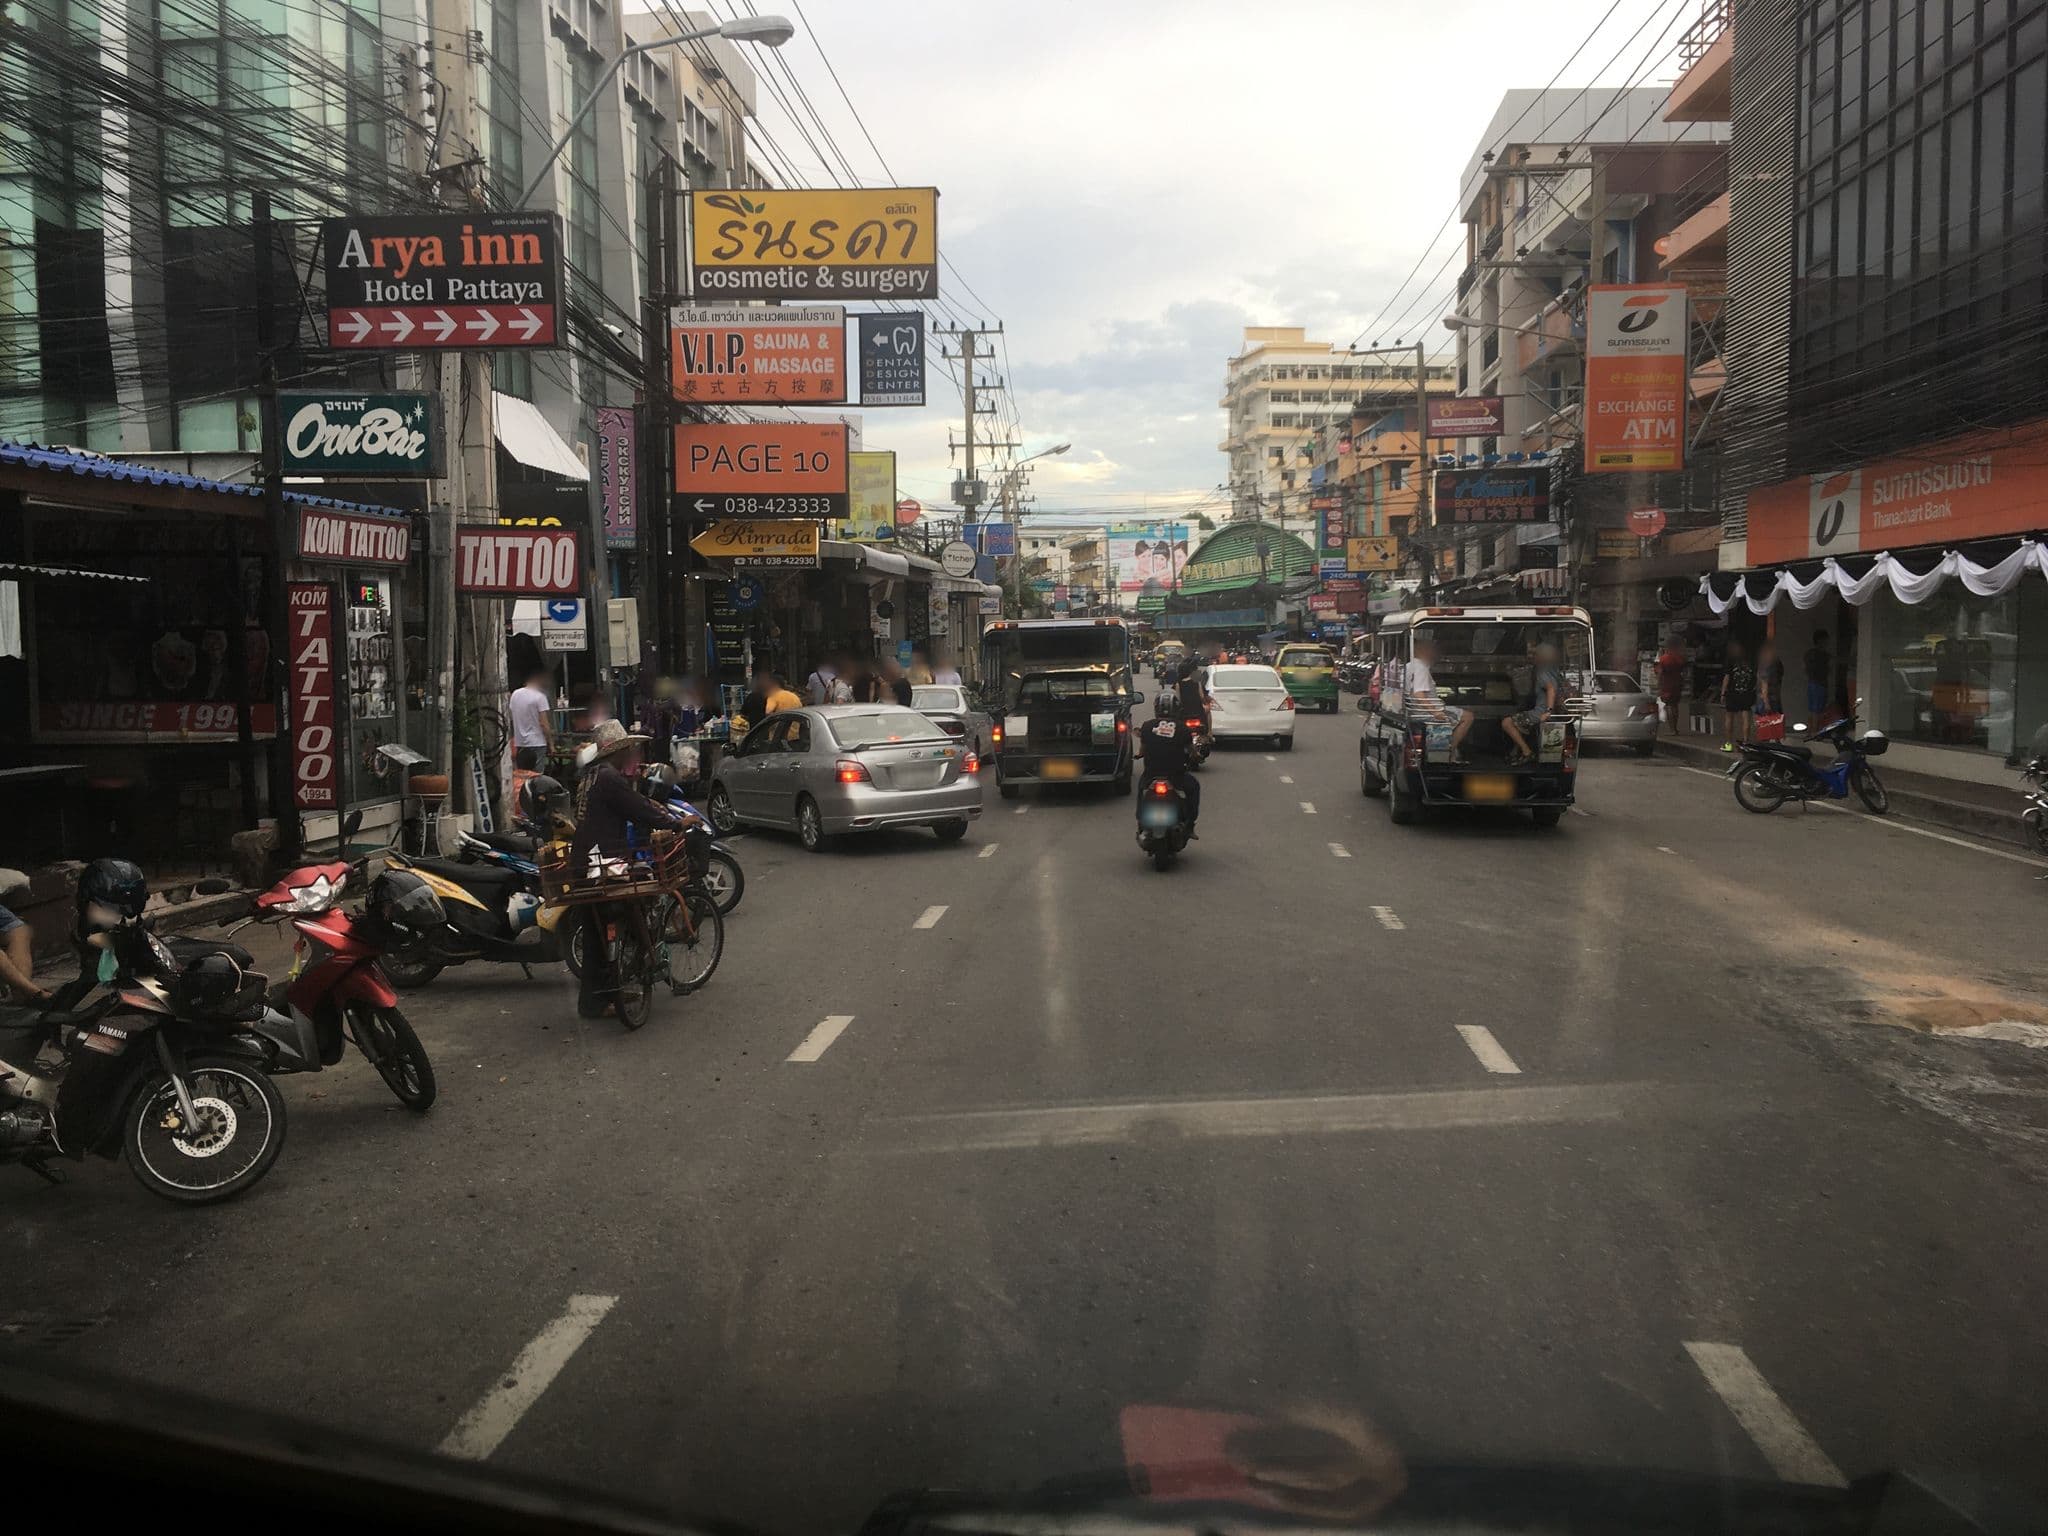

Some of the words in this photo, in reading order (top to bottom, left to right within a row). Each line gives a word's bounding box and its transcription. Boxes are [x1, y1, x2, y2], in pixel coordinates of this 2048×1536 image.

[885, 203, 917, 215] คลินิก
[338, 229, 446, 279] Arya
[460, 225, 543, 267] inn
[700, 267, 808, 289] cosmetic
[815, 266, 834, 288] &
[841, 269, 929, 292] surgery
[364, 278, 434, 302] Hotel
[448, 278, 543, 304] Pattaya
[753, 332, 810, 350] SAUNA
[817, 332, 829, 349] &
[680, 332, 748, 376] V.I.P.
[866, 358, 920, 367] DENTAL
[753, 357, 835, 374] MASSAGE
[866, 369, 920, 378] DESIGN
[866, 381, 920, 390] CENTER
[1598, 400, 1676, 413] EXCHANGE
[1623, 418, 1676, 440] ATM
[689, 444, 783, 474] PAGE
[792, 451, 830, 474] 10
[724, 497, 831, 514] 038-423333
[1873, 504, 1923, 529] Thanachart
[1924, 498, 1952, 521] Bank
[303, 517, 346, 555] KOM
[348, 523, 408, 561] TATTOO
[460, 535, 576, 589] TATTOO
[747, 557, 763, 565] Tel.
[766, 557, 815, 565] 038-422930
[291, 590, 327, 606] KOM
[295, 610, 332, 781] TATTOO
[303, 788, 328, 800] 1994
[472, 758, 491, 833] ATTOO
[97, 1024, 128, 1041] YAMAHA
